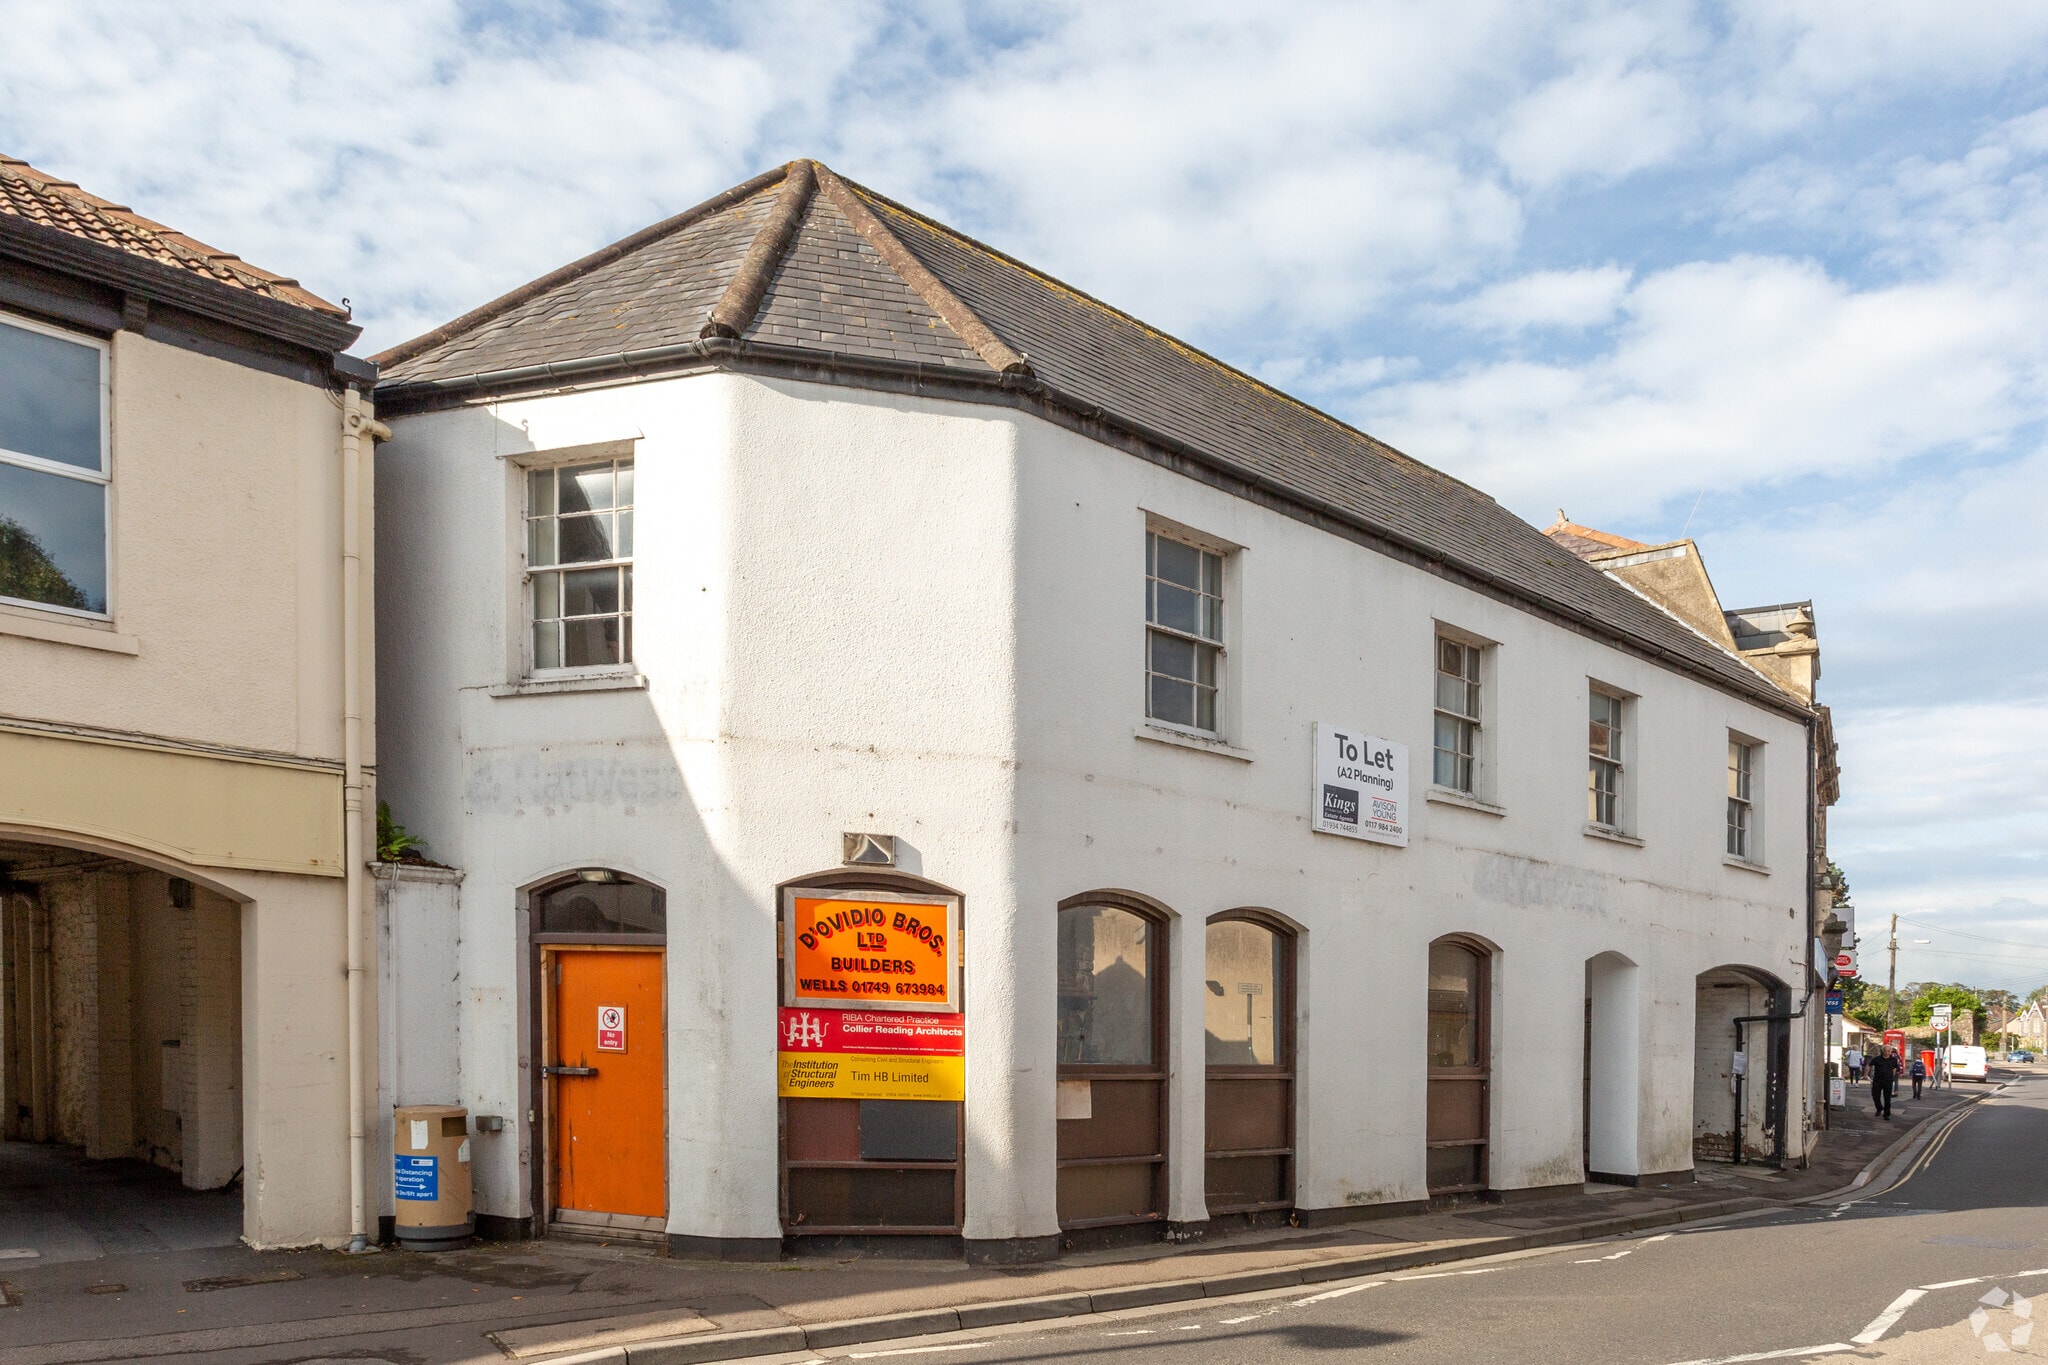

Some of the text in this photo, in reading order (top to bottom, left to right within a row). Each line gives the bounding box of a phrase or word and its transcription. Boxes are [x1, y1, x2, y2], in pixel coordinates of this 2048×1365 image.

[1334, 732, 1394, 771] To Let
[1337, 766, 1394, 792] (A2 Planning)
[1325, 793, 1356, 814] Kings
[1372, 799, 1397, 812] AVISON
[1372, 808, 1397, 821] YOUNG
[1322, 820, 1339, 830] 01934
[1365, 820, 1403, 834] 0117 984 2400
[798, 907, 945, 957] D'OVIDIO BROS.
[831, 957, 915, 974] BUILDERS
[800, 978, 946, 996] WELLS 01749 673984
[842, 1013, 939, 1025] RIBA Chartered Practice
[842, 1024, 963, 1036] Collier Reading Architects
[781, 1059, 839, 1070] The Institution
[791, 1069, 837, 1079] Structural
[851, 1070, 929, 1083] Tim HB Limited
[788, 1078, 835, 1090] Engineers
[402, 1169, 433, 1177] Distancing
